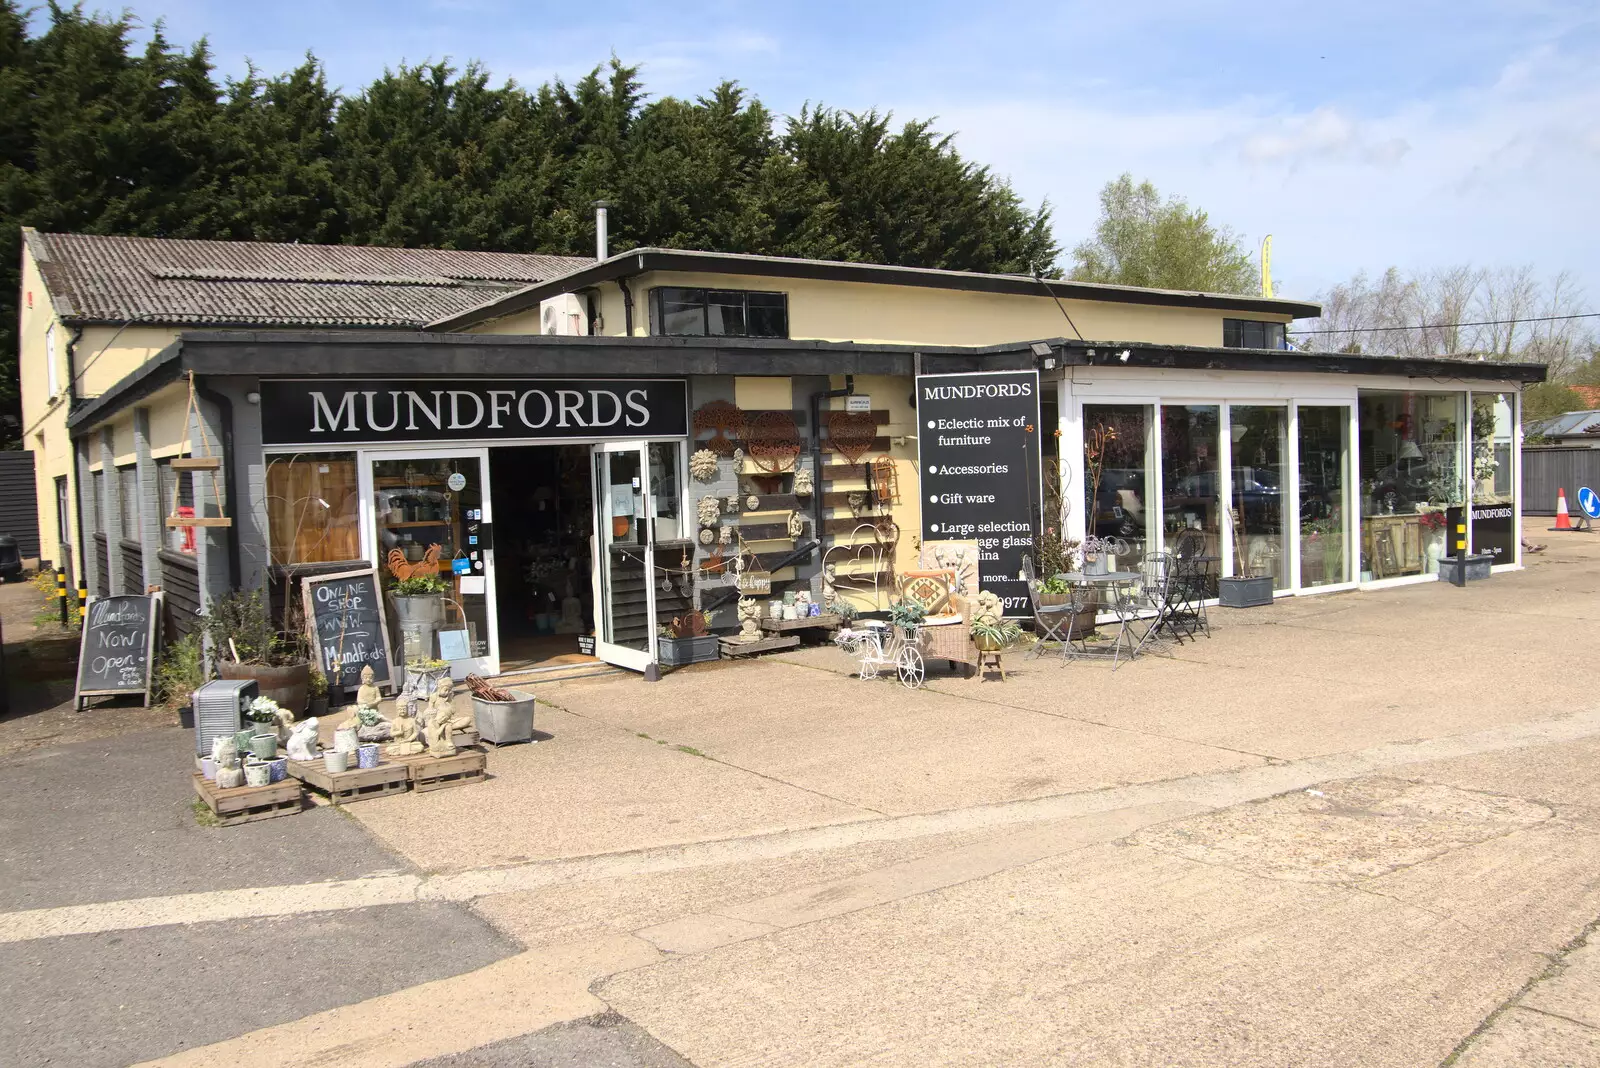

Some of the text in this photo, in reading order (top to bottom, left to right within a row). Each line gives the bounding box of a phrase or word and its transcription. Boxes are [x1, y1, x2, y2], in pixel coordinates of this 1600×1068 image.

[925, 383, 1032, 400] MUNDFORDS
[308, 389, 650, 433] MUNDFORDS
[938, 416, 1026, 430] Eclectic mix of
[938, 435, 991, 446] furniture
[939, 463, 1009, 475] Accessories
[940, 494, 995, 504] Gift ware
[1472, 508, 1512, 520] MUNDFORDS
[941, 521, 1030, 536] Large selection
[1003, 536, 1032, 549] glass
[328, 597, 361, 611] SHOP
